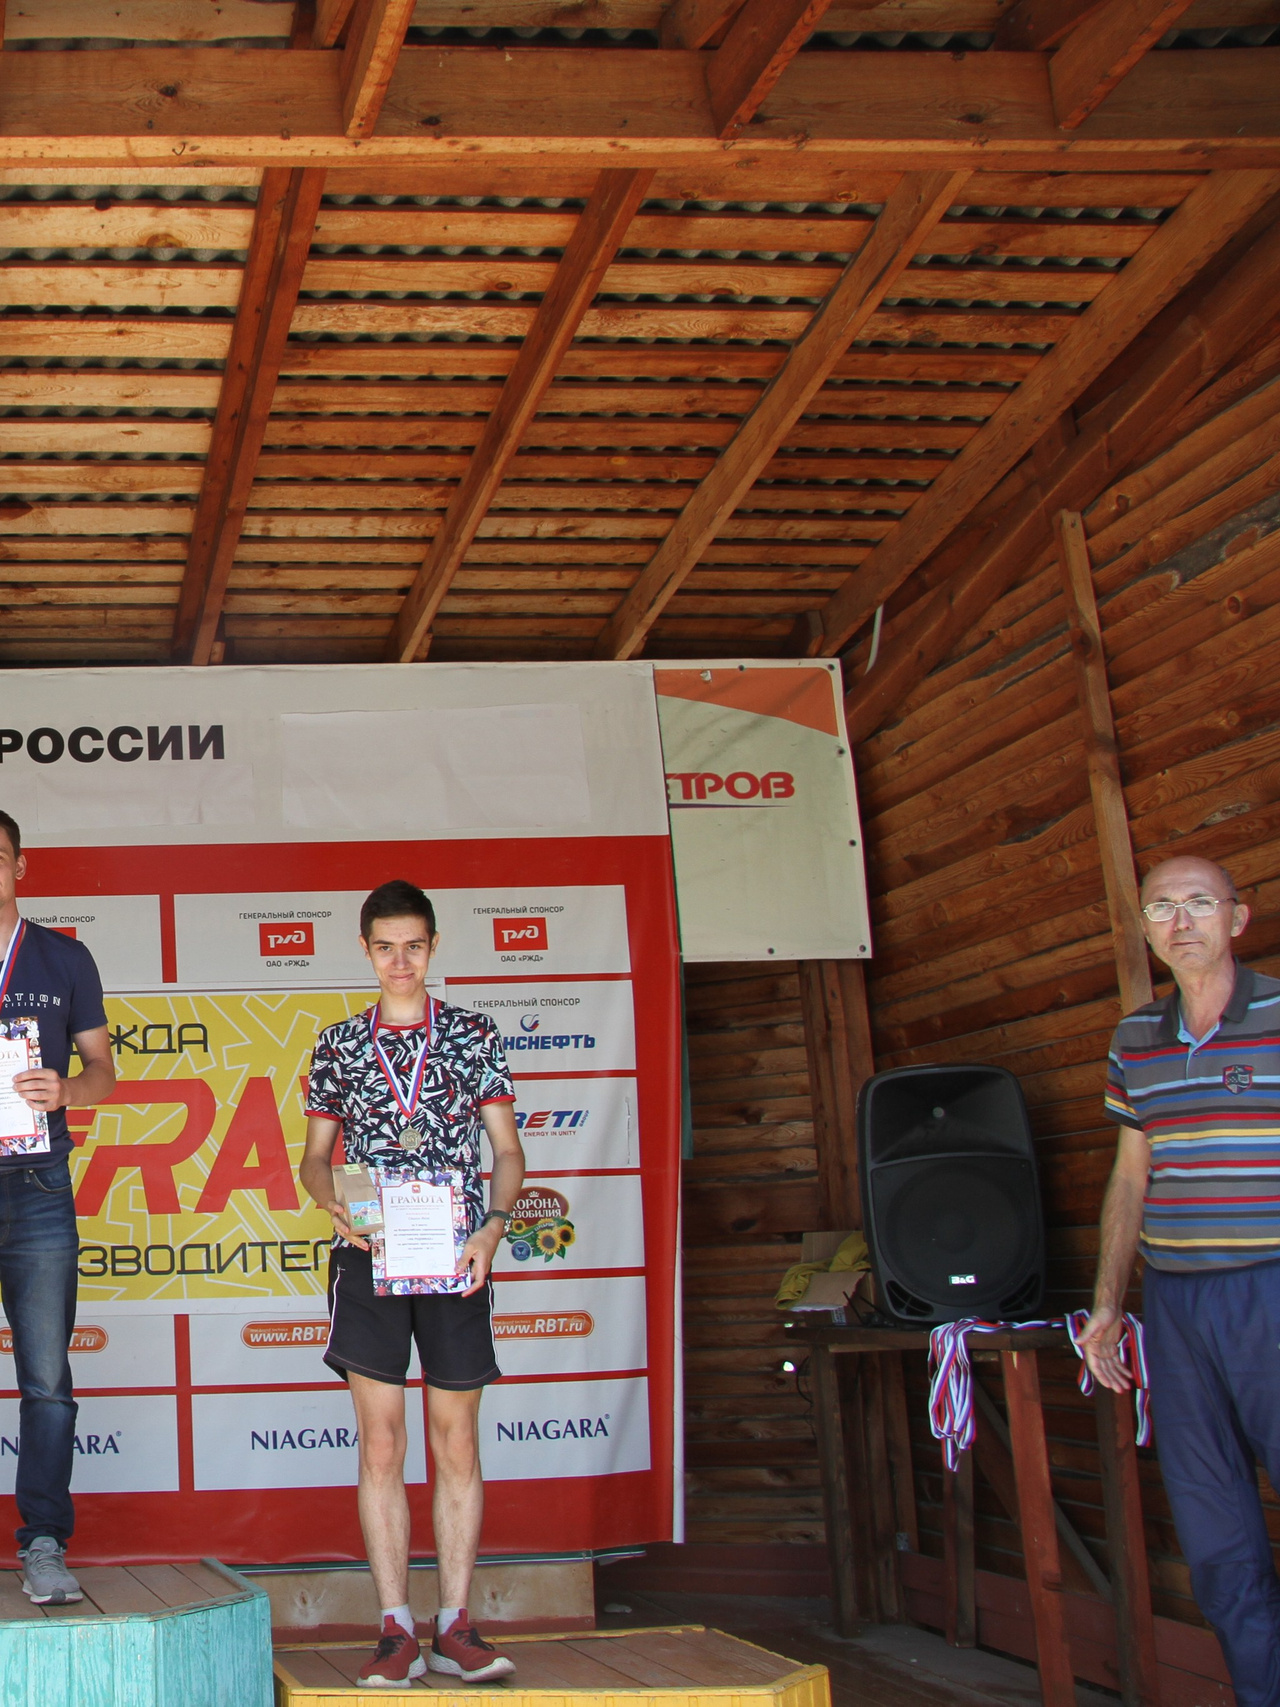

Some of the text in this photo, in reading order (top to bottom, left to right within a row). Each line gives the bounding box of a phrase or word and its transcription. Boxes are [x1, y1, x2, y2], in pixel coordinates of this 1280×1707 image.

[665, 771, 795, 800] ТРОВ
[239, 910, 332, 919] ГЕНЕРАЛЬНЫЙ СПОНСОР
[473, 905, 565, 915] ГЕНЕРАЛЬНЫЙ СПОНСОР
[59, 915, 96, 923] СПОНСОР
[283, 959, 310, 967] «РЖД»
[518, 954, 544, 962] «РЖД»
[5, 1001, 48, 1009] CISIONS
[473, 997, 581, 1008] ГЕНЕРАЛЬНЫЙ СПОНСОР
[108, 1023, 209, 1055] ЖДА
[503, 1034, 596, 1051] НСНЕФТЬ
[390, 1194, 445, 1204] ГРАМОТА
[494, 1318, 583, 1335] www.RBT.ru
[250, 1326, 327, 1343] www.RBT.
[496, 1417, 609, 1442] NIAGARA
[1, 1433, 120, 1457] NARA
